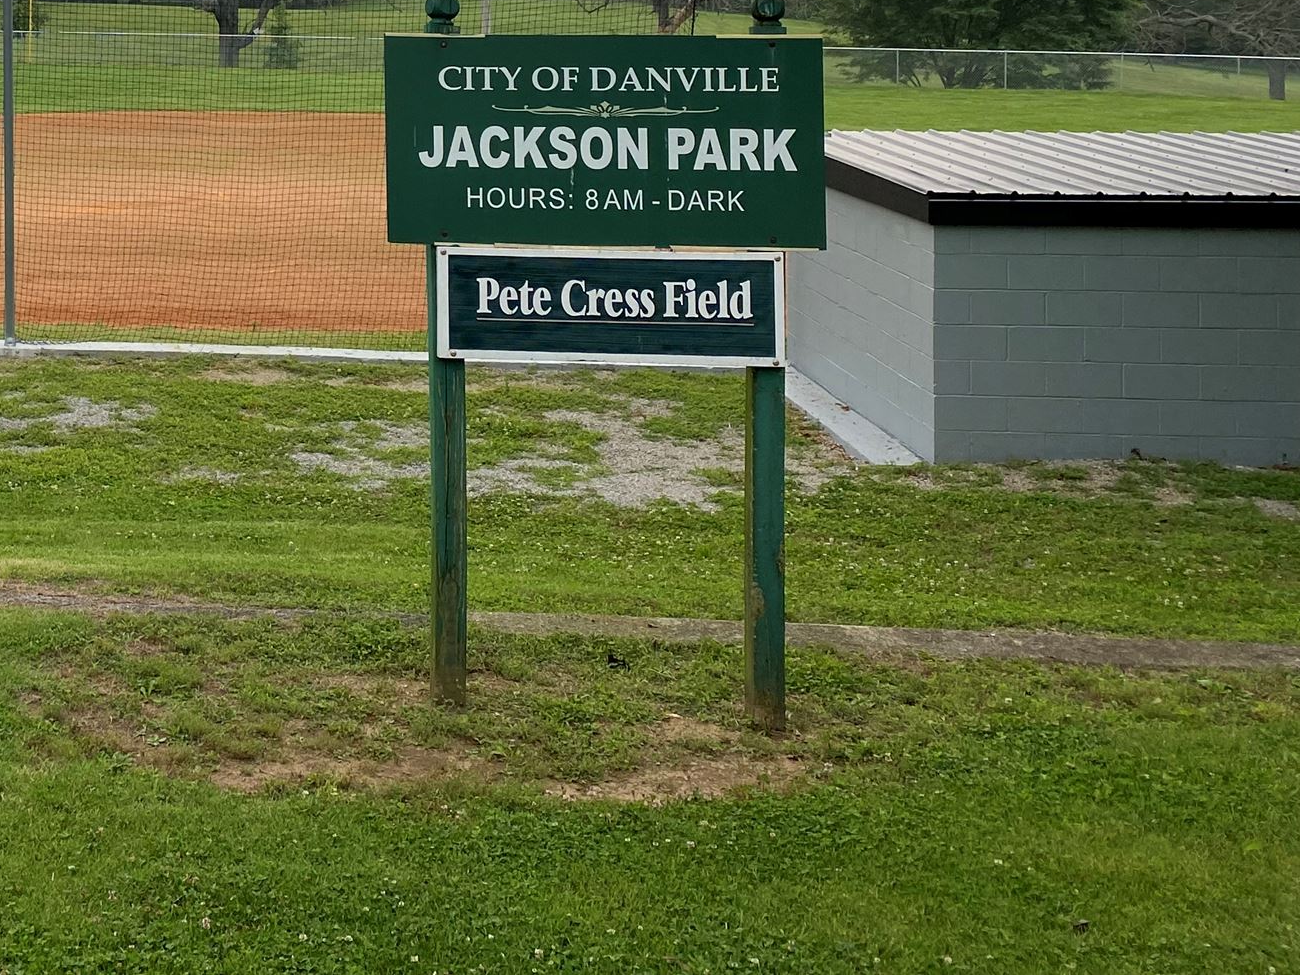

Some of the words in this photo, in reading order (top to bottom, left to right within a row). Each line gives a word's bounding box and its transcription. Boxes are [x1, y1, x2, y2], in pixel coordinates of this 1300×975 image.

[438, 66, 522, 91] CITY
[531, 66, 579, 91] OF
[589, 67, 780, 92] DANVILLE
[419, 125, 648, 170] JACKSON
[668, 128, 797, 172] PARK
[466, 187, 574, 210] HOURS:
[668, 190, 745, 212] DARK
[476, 277, 552, 316] Pete
[561, 279, 655, 318] Cress
[663, 278, 753, 319] Field
